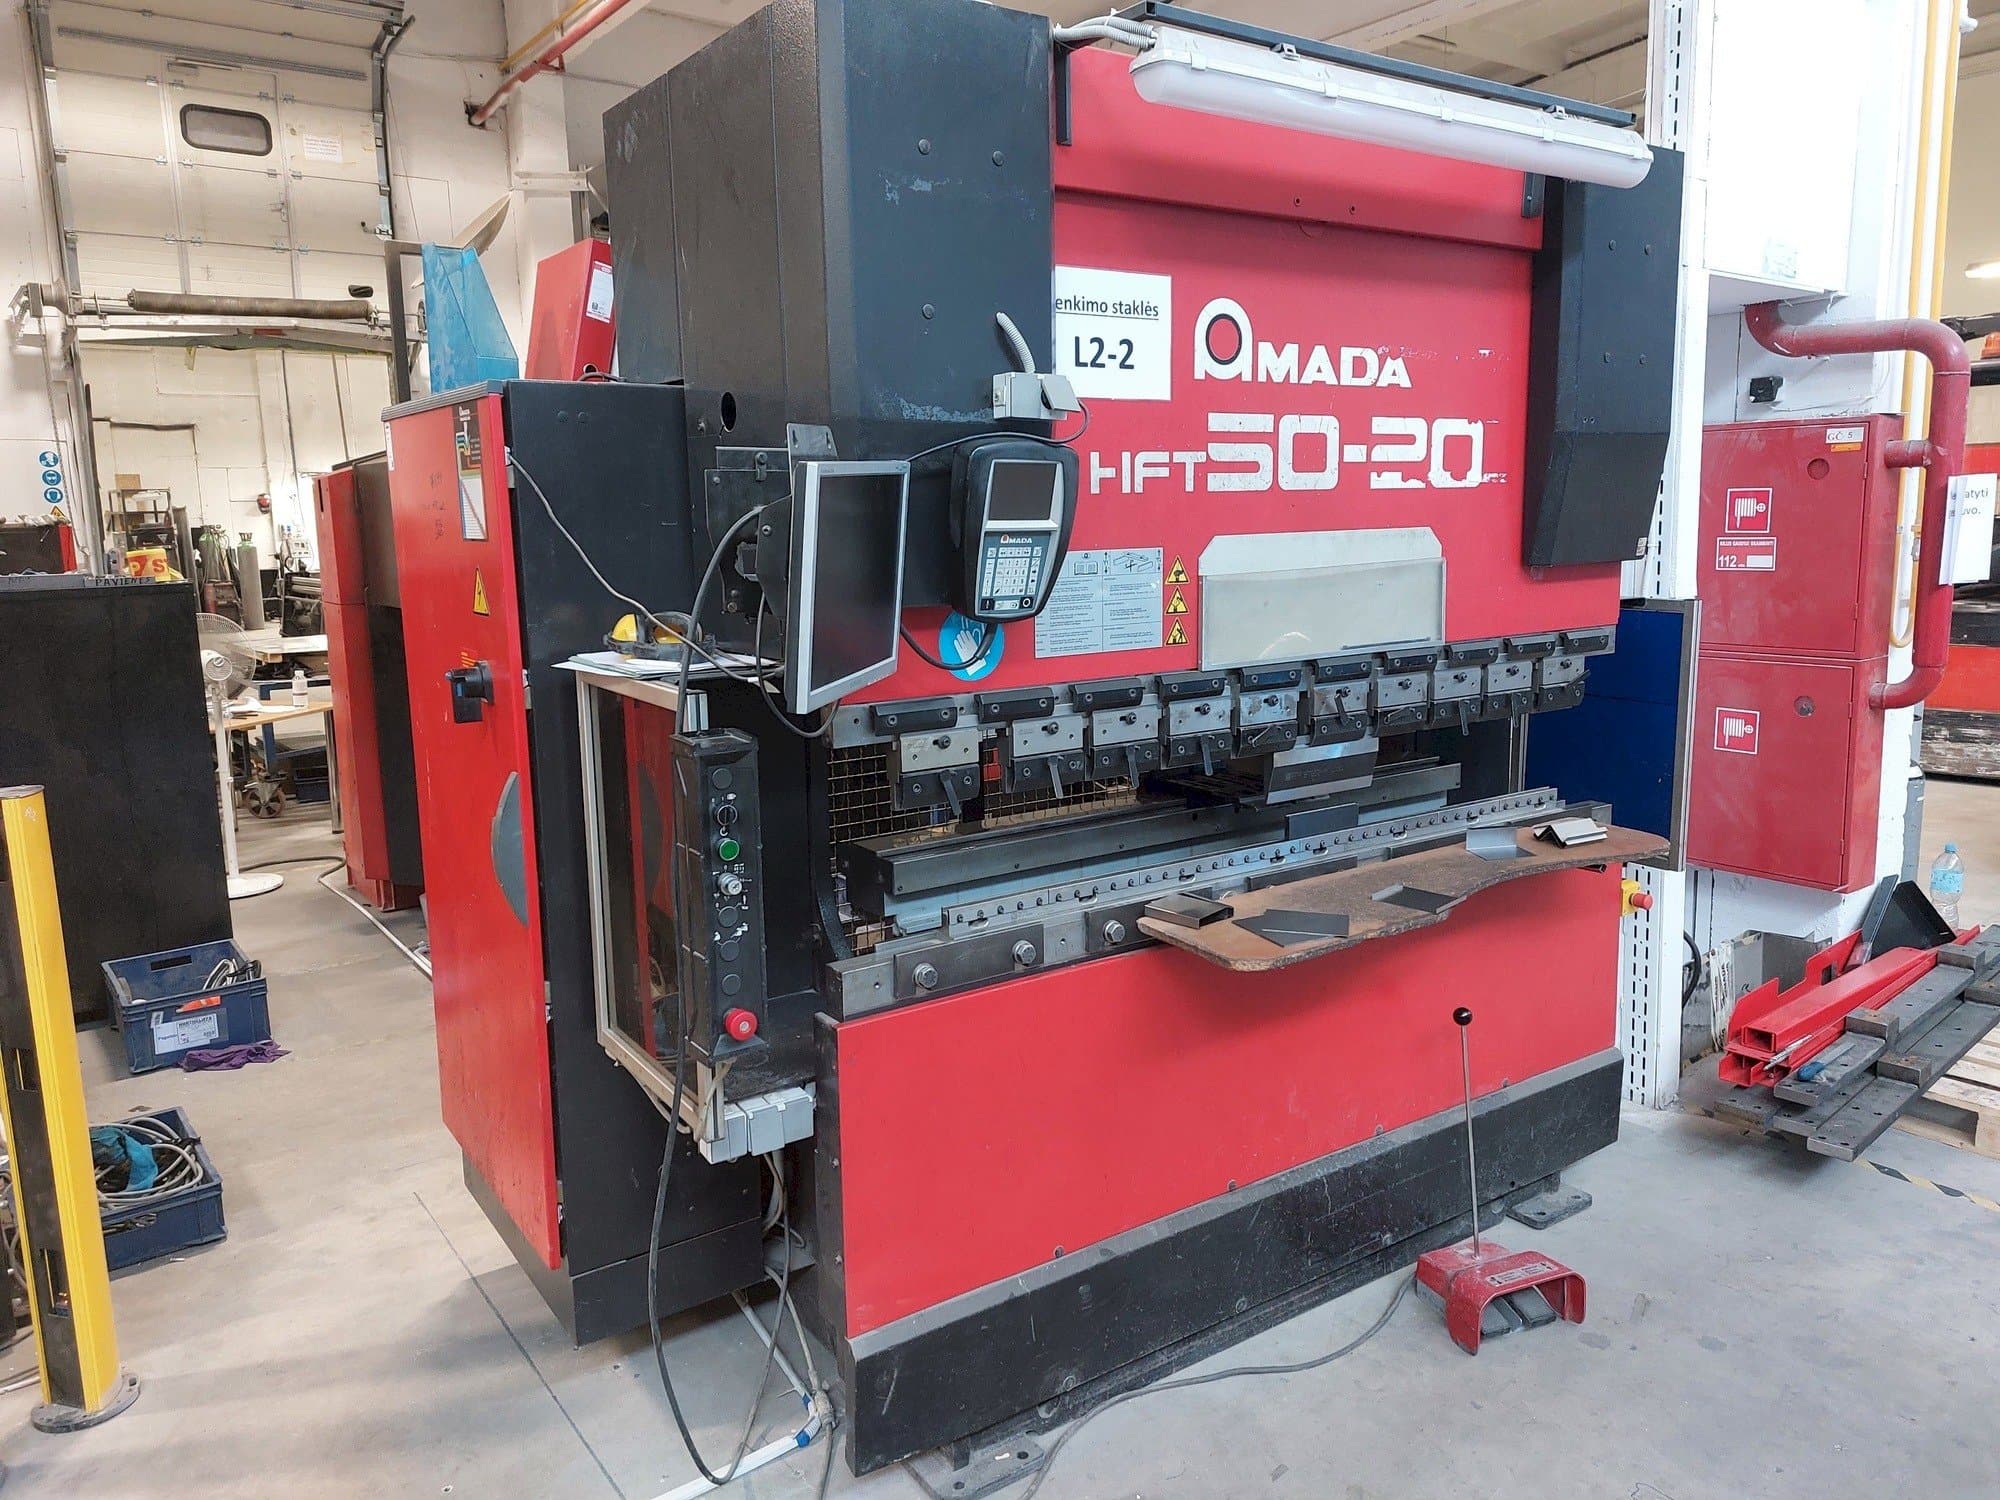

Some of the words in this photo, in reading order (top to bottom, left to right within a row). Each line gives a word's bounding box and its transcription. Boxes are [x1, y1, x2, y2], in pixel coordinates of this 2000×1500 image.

[1056, 294, 1108, 313] enkimo
[1112, 300, 1159, 317] staklės
[1194, 297, 1412, 388] AMADA
[1074, 335, 1135, 370] L2-2
[1964, 488, 1989, 500] atyti
[1000, 534, 1032, 544] AMADA
[1718, 555, 1737, 567] 112
